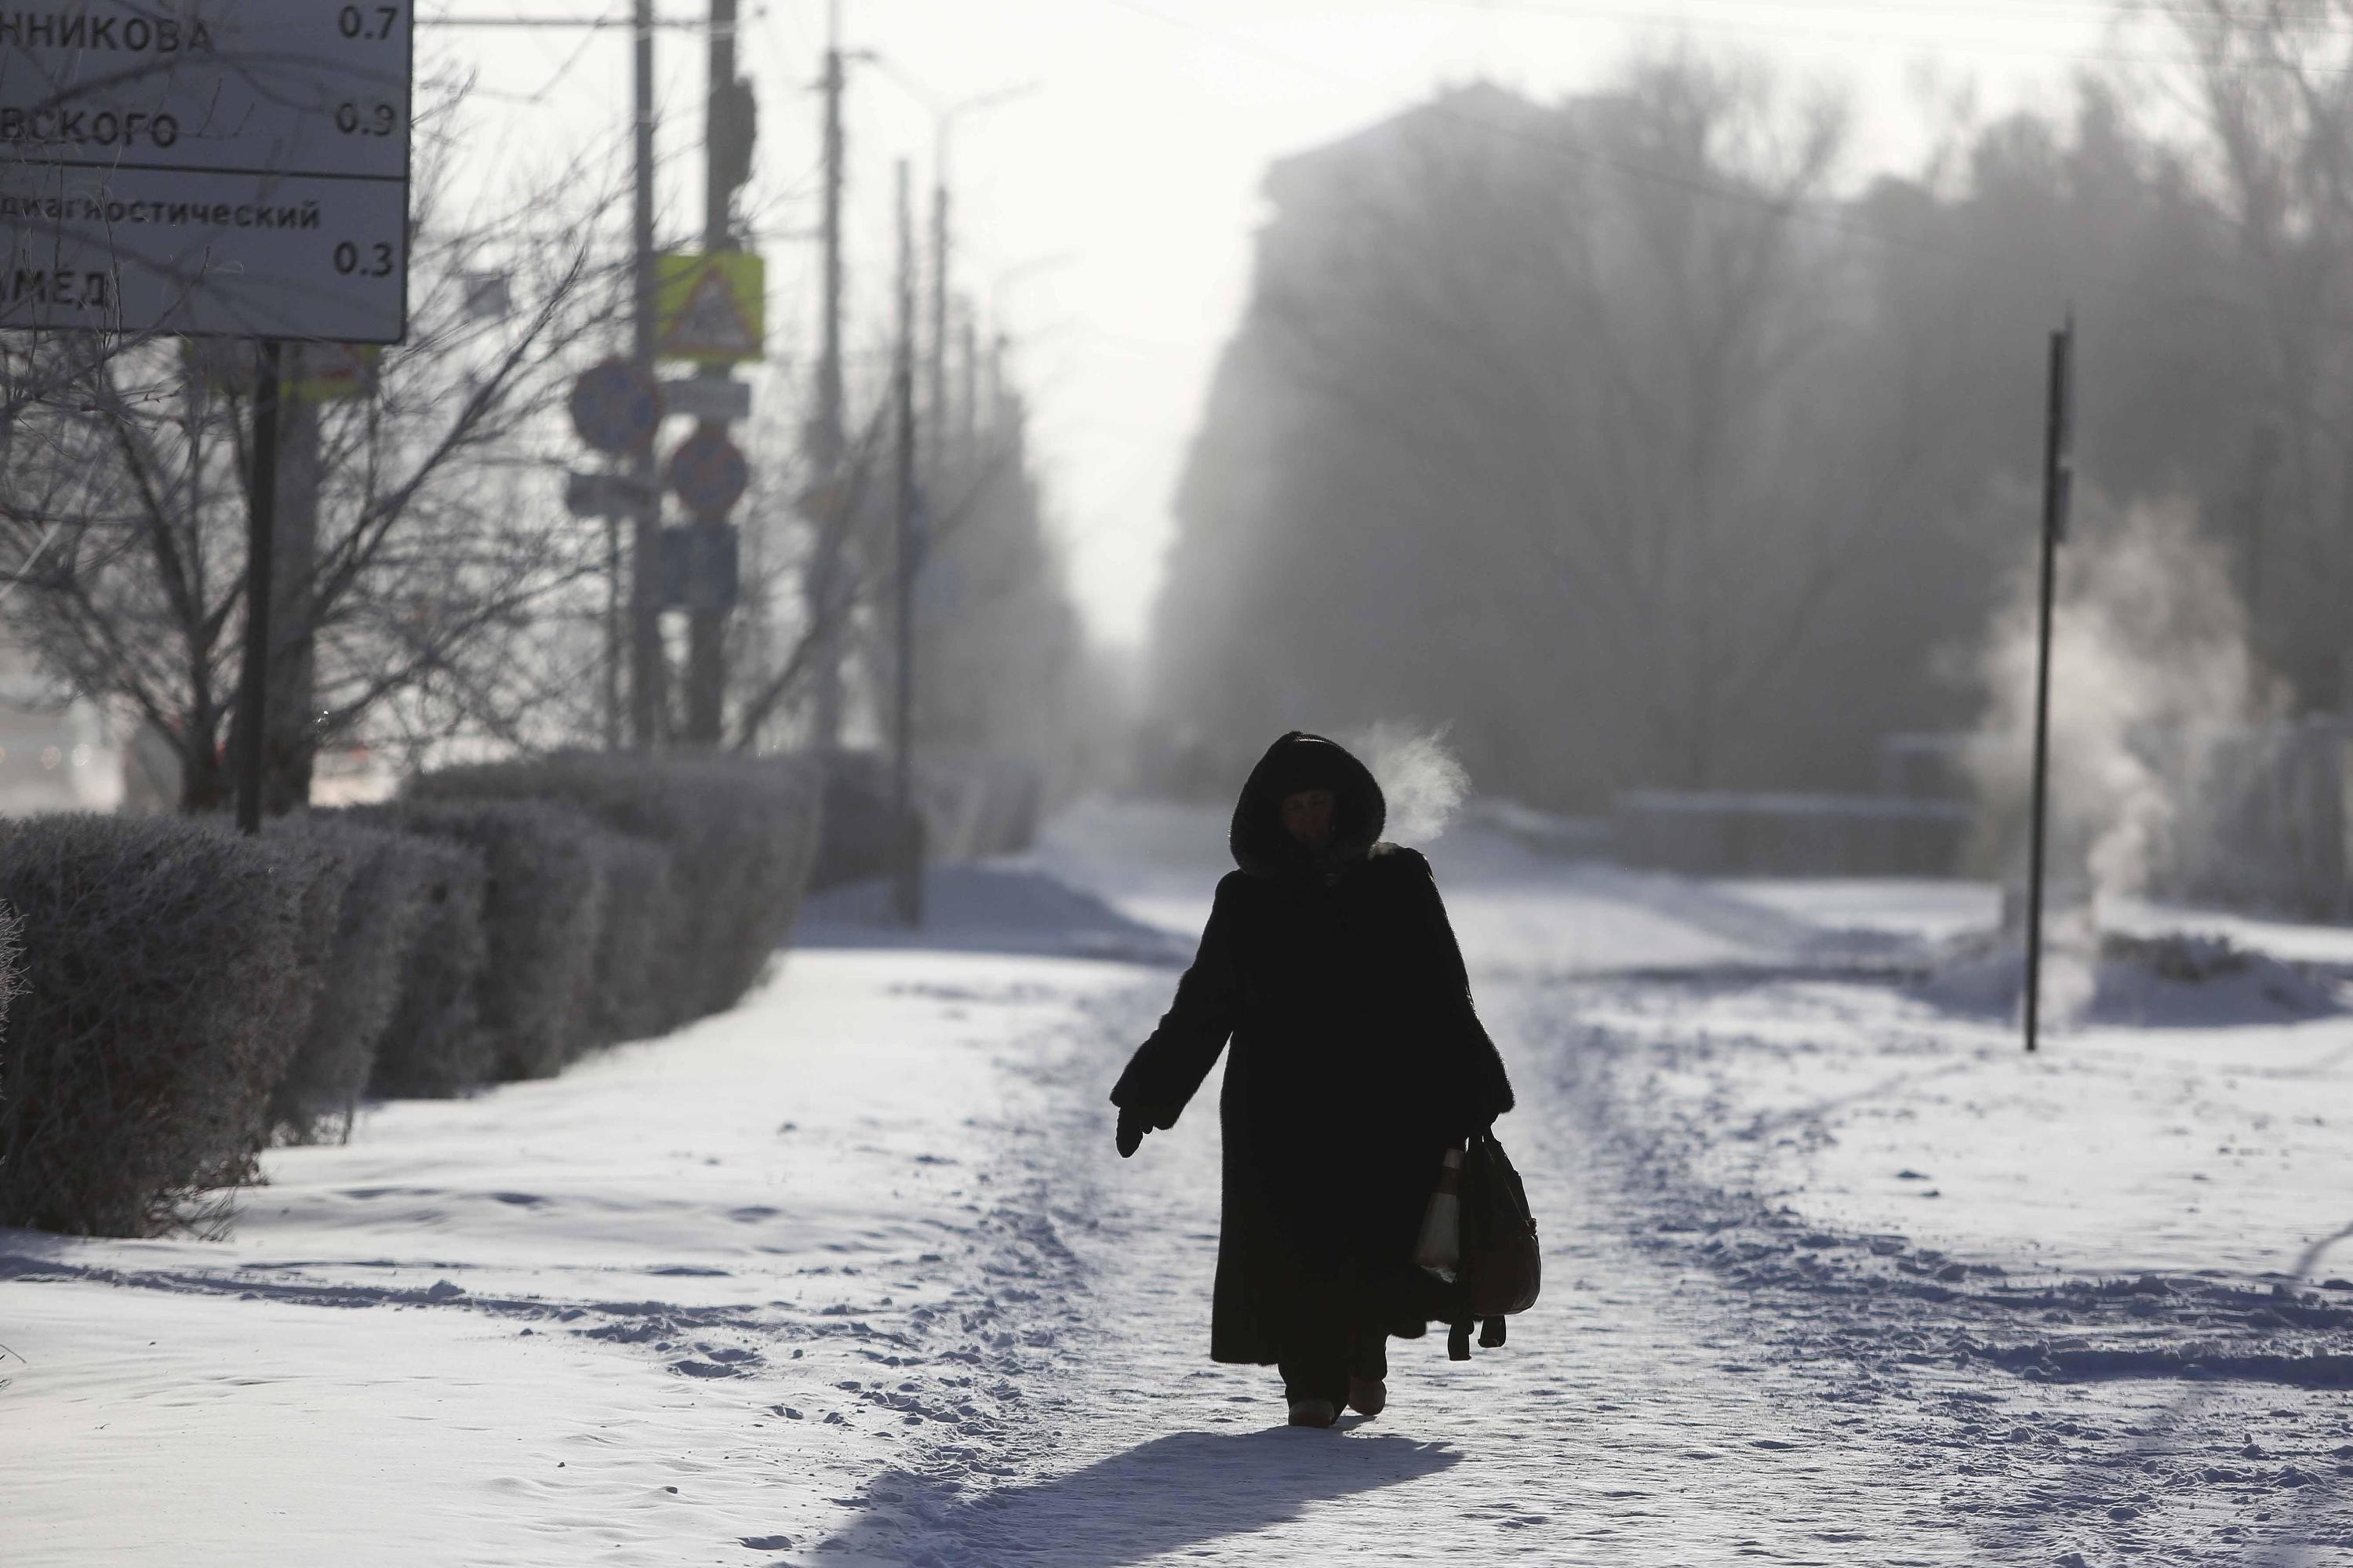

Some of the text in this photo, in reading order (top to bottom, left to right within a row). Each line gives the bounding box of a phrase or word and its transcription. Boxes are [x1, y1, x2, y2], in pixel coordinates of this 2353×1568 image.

[339, 5, 398, 40] 0.7
[0, 103, 395, 147] ВСКОГО 0.9
[2, 197, 321, 228] диагностический
[333, 240, 393, 278] 0.3
[0, 270, 107, 309] МЕД
